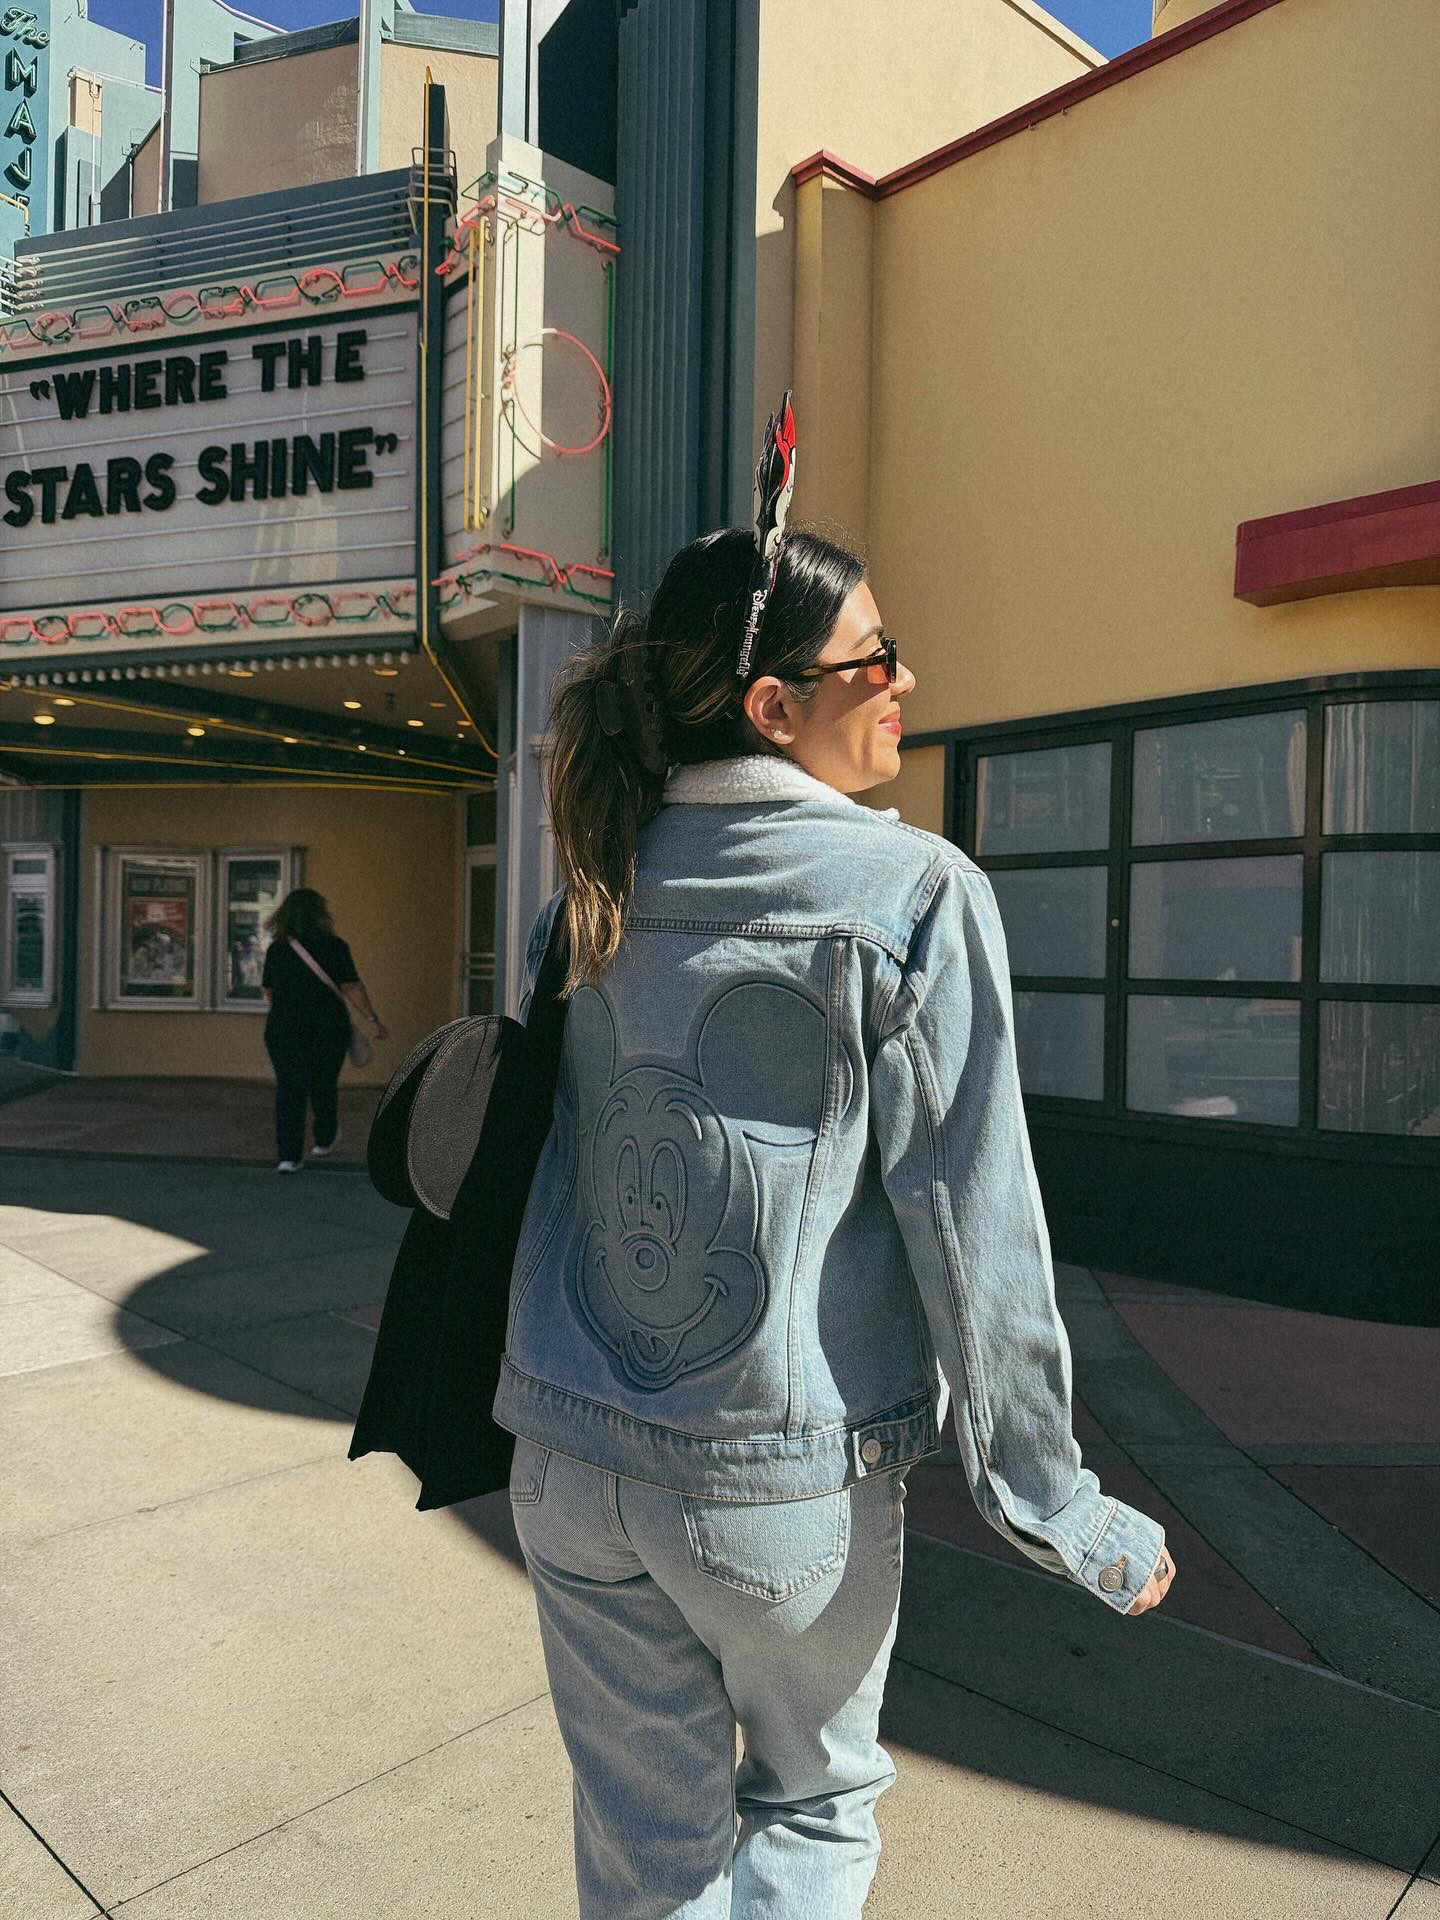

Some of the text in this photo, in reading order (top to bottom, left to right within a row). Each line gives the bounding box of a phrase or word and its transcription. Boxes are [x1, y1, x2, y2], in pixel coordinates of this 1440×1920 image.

[0, 7, 50, 49] The
[252, 329, 368, 393] THE
[3, 452, 177, 528] STARS
[746, 589, 768, 627] Disney
